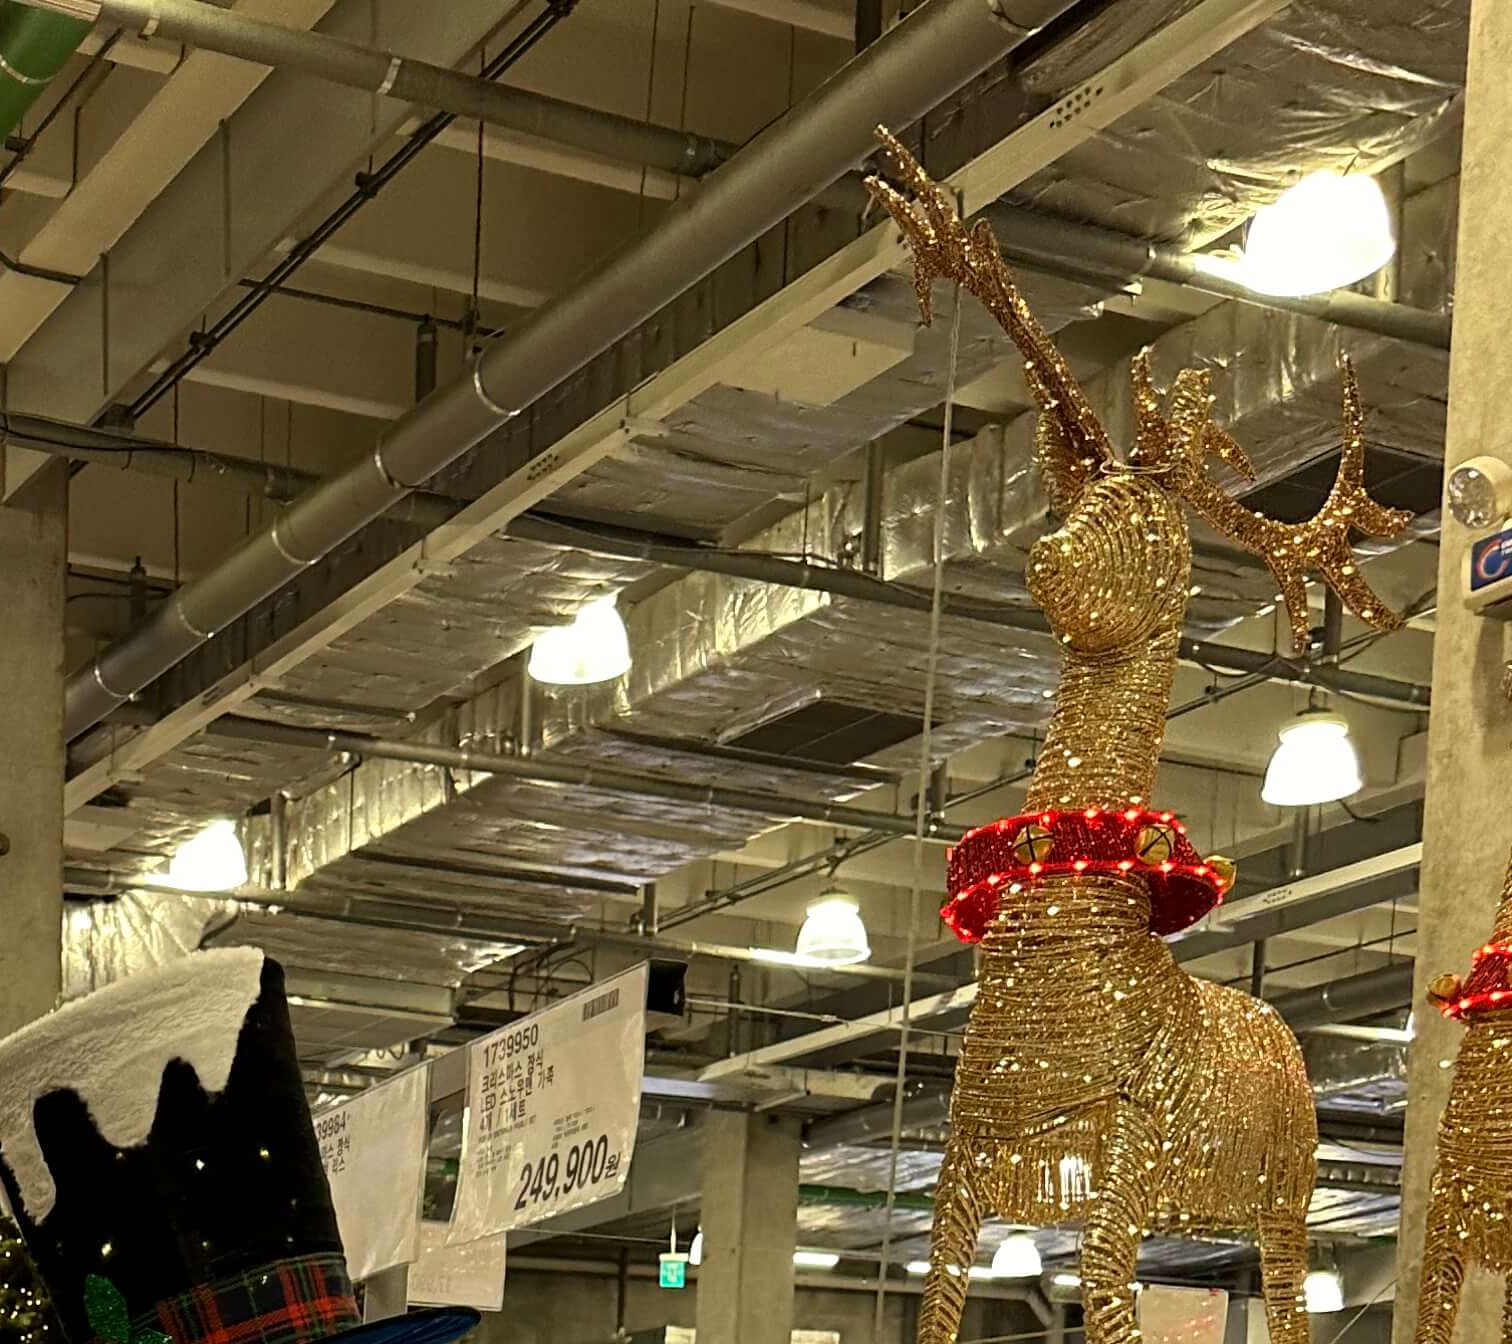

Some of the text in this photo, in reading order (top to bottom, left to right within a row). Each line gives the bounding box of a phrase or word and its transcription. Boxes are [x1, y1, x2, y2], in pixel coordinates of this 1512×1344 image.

[484, 1023, 539, 1068] 1739950
[481, 1048, 544, 1093] 크리스마스 장식
[537, 1065, 555, 1090] 가족
